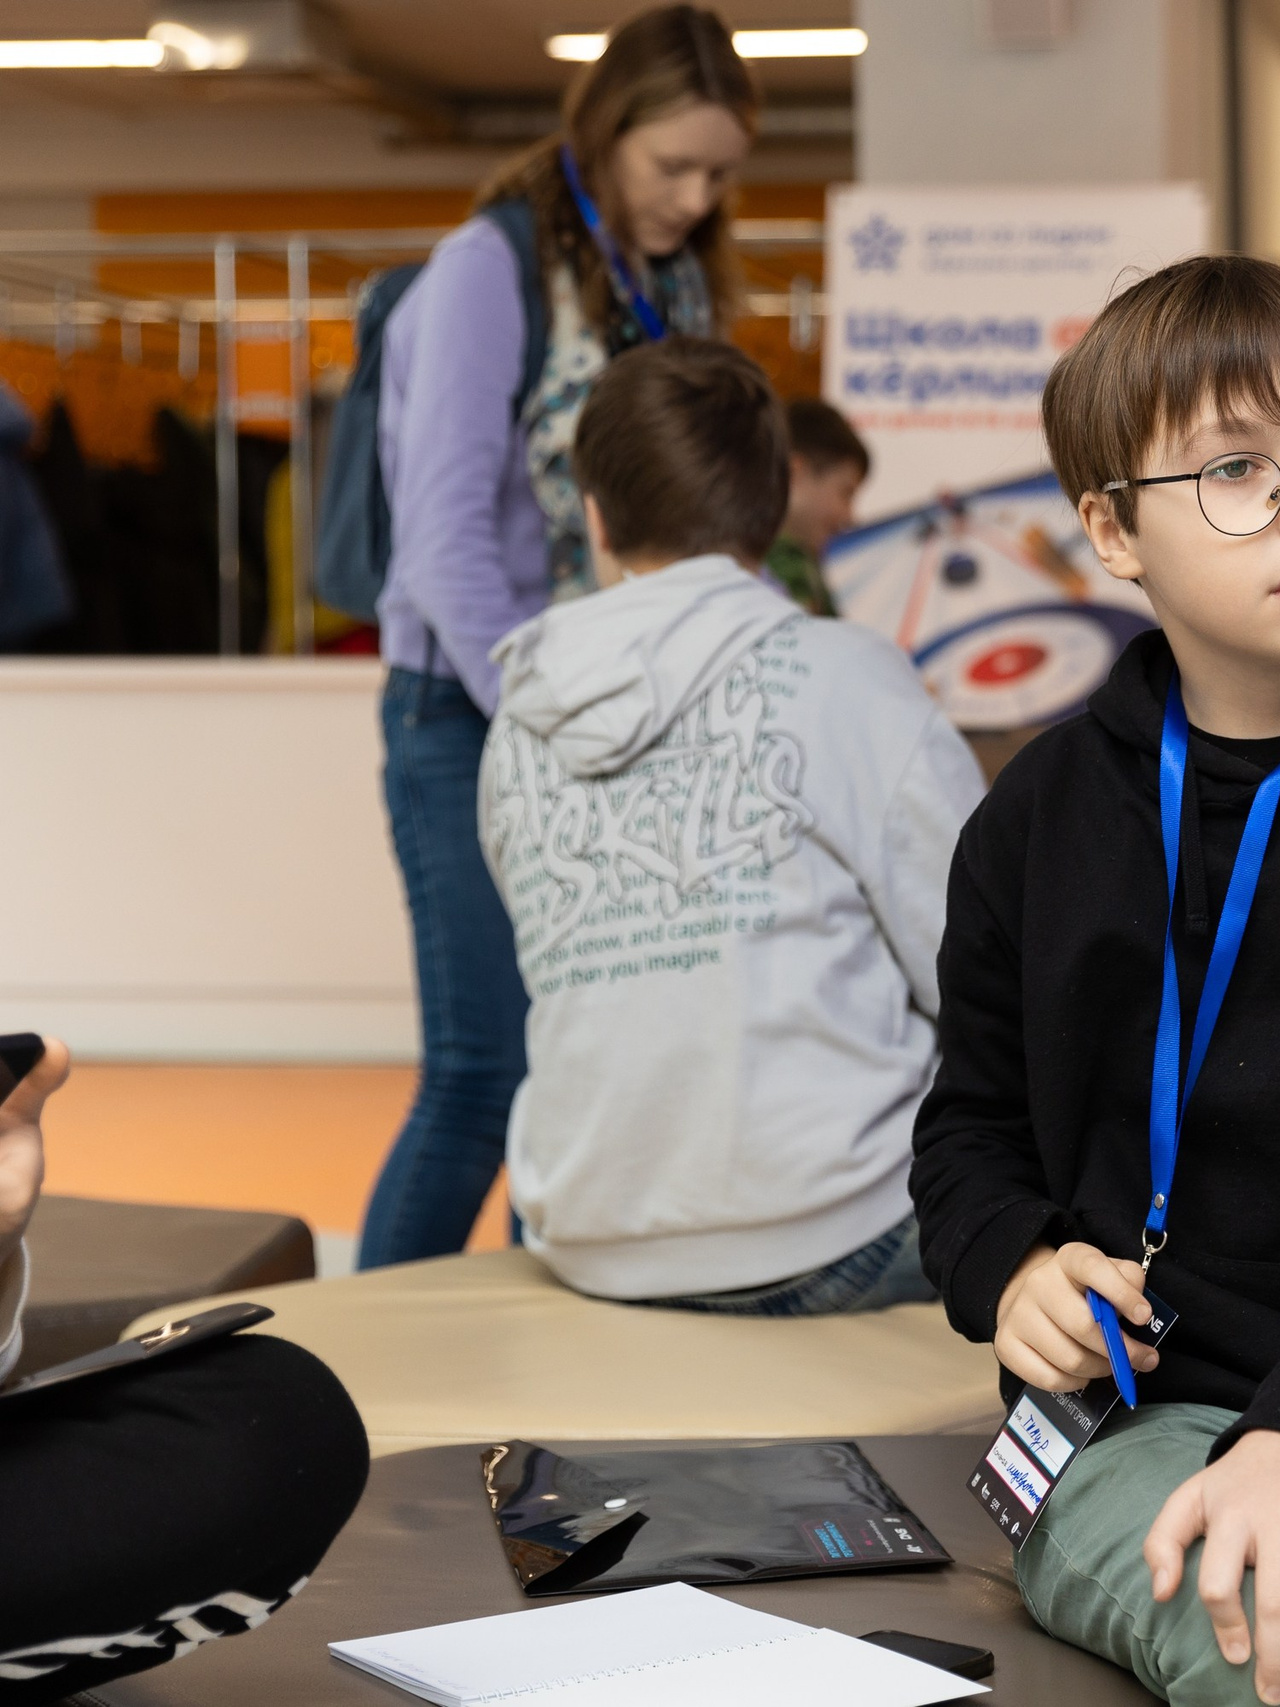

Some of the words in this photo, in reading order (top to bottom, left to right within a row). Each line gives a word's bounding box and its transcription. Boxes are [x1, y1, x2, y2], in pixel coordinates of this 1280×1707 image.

[845, 314, 1042, 351] Школа
[845, 360, 1048, 404] кёрлин
[629, 922, 666, 944] and
[752, 909, 778, 933] of
[605, 958, 643, 984] you
[645, 948, 721, 973] imagine
